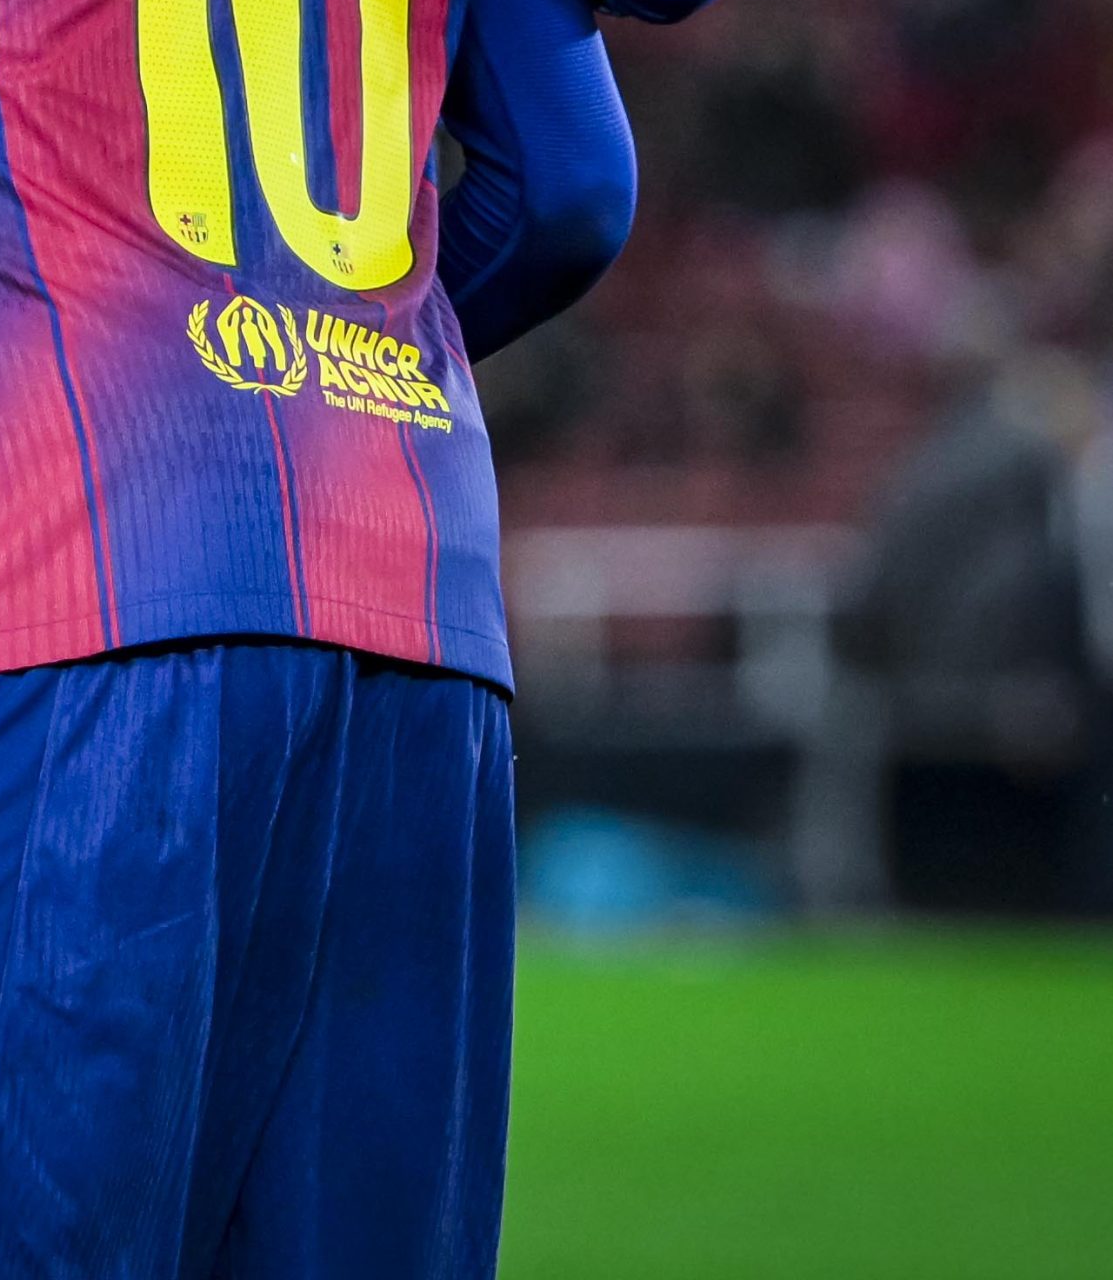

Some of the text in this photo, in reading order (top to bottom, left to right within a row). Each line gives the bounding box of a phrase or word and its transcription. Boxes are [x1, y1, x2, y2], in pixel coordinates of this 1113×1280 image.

[305, 308, 430, 382] UNHCR
[317, 353, 452, 413] ACNUR
[322, 390, 453, 434] The UN Refugee Agency
